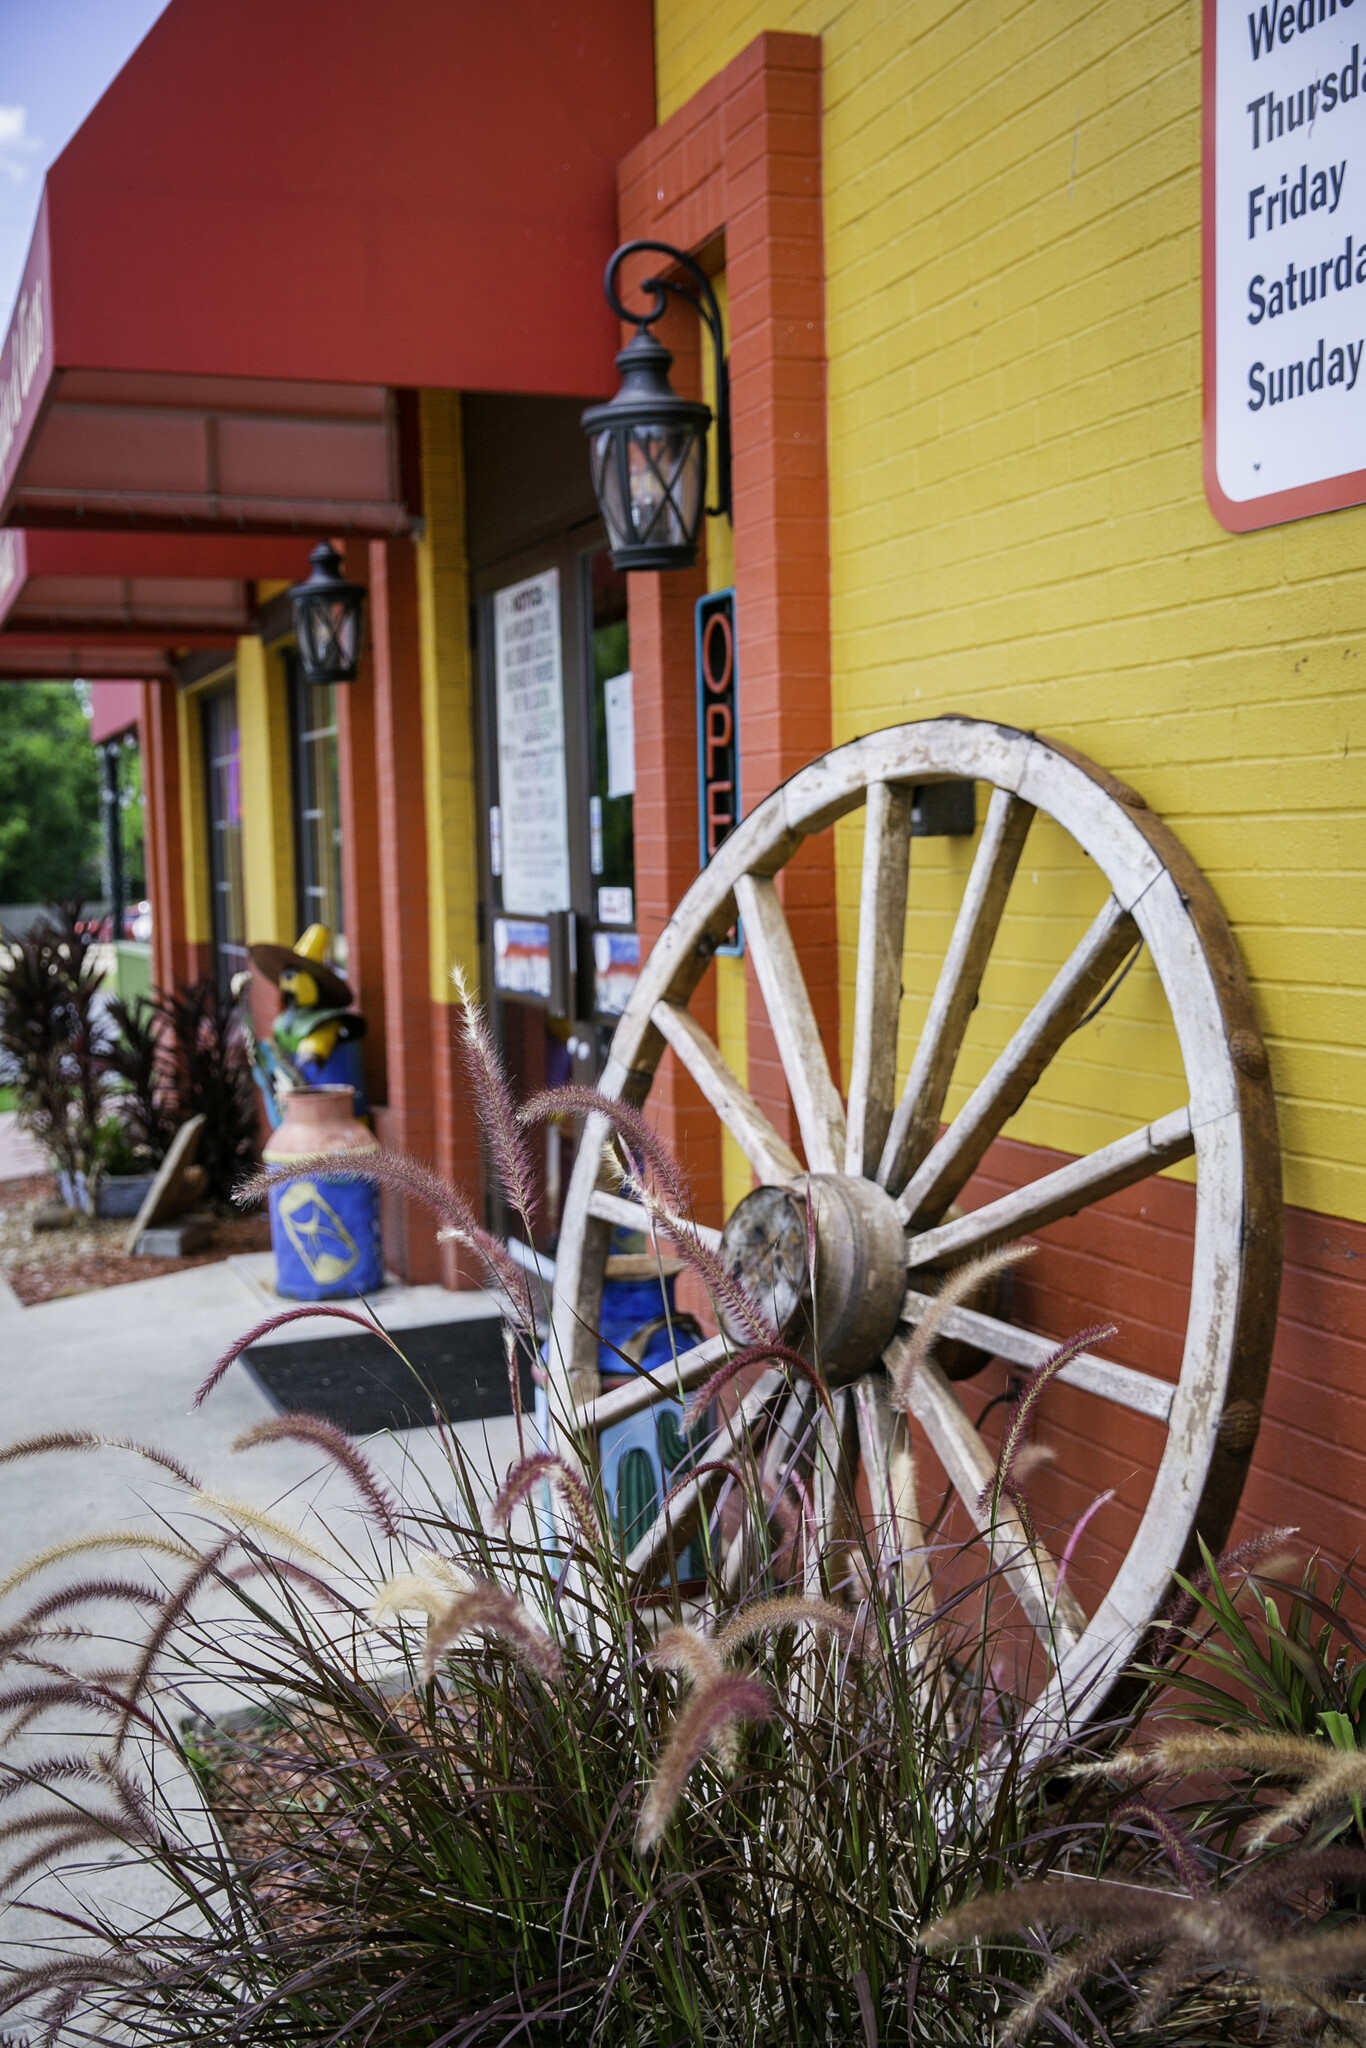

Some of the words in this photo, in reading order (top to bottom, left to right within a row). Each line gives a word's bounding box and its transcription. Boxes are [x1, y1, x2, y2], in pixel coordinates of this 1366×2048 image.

[1247, 0, 1357, 61] Wed
[1248, 160, 1347, 240] Friday
[1247, 338, 1364, 412] Sunday
[703, 612, 735, 940] OPE
